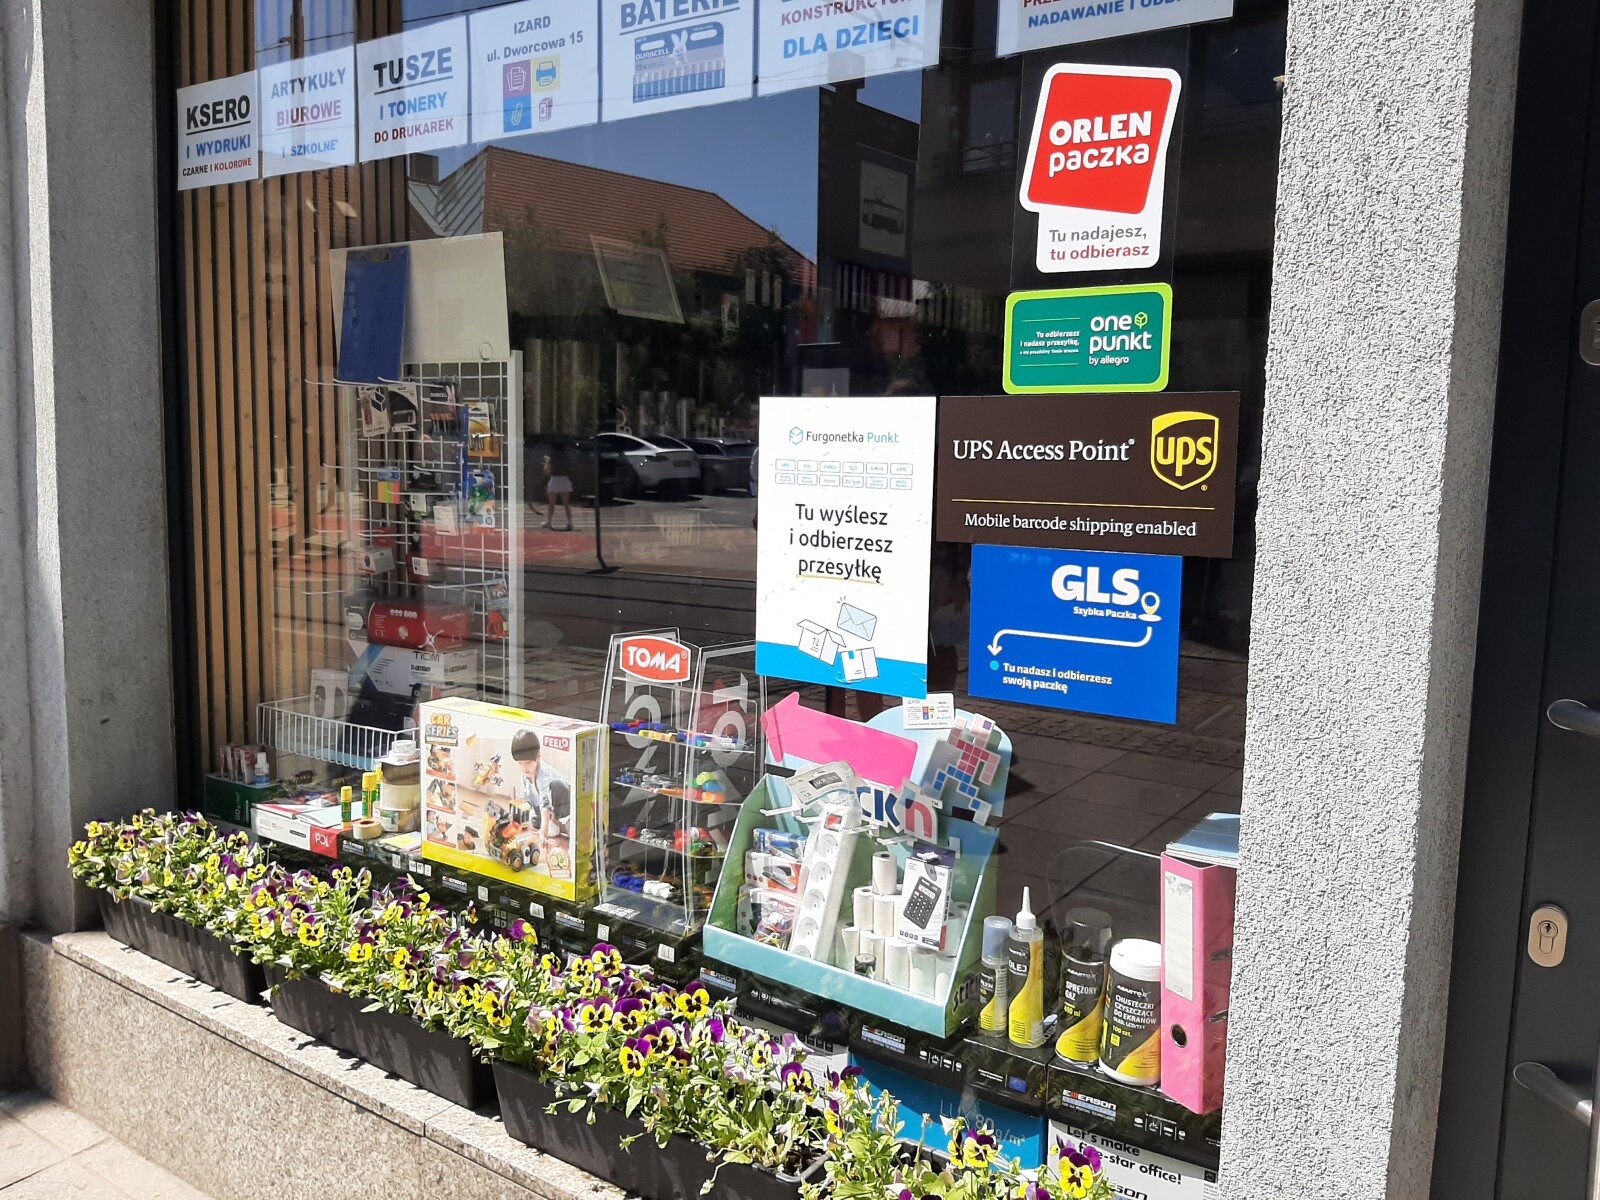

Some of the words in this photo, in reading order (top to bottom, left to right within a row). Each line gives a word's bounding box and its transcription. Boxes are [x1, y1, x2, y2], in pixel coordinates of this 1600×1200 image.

[514, 15, 551, 35] IZARD
[1028, 1, 1124, 28] NADAWANIE
[487, 47, 500, 63] ul.
[503, 36, 566, 59] Dworcowa
[570, 30, 584, 45] 15
[783, 33, 828, 59] DLA
[836, 15, 919, 49] DZIECI
[373, 47, 453, 88] TUSZE
[271, 67, 347, 99] ARTYKUŁY
[186, 94, 251, 130] KSERO
[276, 100, 342, 127] BIUROWE
[388, 91, 448, 118] TONERY
[374, 130, 389, 144] DO
[391, 118, 454, 141] DRUKAREK
[1049, 110, 1152, 146] ORLEN
[196, 134, 251, 156] WYDRUKI
[290, 139, 339, 156] SZKOLNE
[182, 165, 208, 177] CZARNE
[214, 158, 252, 172] KOLOROWE
[1049, 143, 1150, 178] paczka
[1049, 229, 1067, 242] Tu
[1071, 225, 1147, 243] nadajesz,
[1050, 248, 1066, 260] tu
[1070, 244, 1150, 260] odbierasz
[1045, 330, 1080, 338] odbierzesz
[1090, 314, 1132, 332] one
[1089, 331, 1152, 354] punkt
[1088, 356, 1099, 366] by
[1100, 355, 1130, 366] allegro
[806, 431, 864, 444] Furgonetka
[867, 431, 899, 444] Punkt
[953, 440, 993, 460] UPS
[996, 440, 1064, 460] Access
[1068, 440, 1130, 461] Point
[795, 503, 814, 521] Tu
[819, 504, 888, 526] wyślesz
[964, 513, 1011, 529] Mobile
[1012, 514, 1068, 531] barcode
[1069, 517, 1133, 537] shipping
[1135, 521, 1197, 537] enabled
[790, 527, 793, 545] i
[799, 529, 893, 553] odbierzesz
[799, 558, 882, 583] przesyłkę
[1051, 564, 1140, 606] GLS
[1073, 606, 1104, 617] Szybka
[1105, 609, 1137, 620] Paczka
[626, 645, 681, 673] TOMA
[1003, 662, 1016, 673] Tu
[1017, 665, 1051, 677] nadasz
[1057, 670, 1112, 684] odbierzesz
[1003, 676, 1032, 689] swoją
[1033, 680, 1068, 694] paczkę
[431, 712, 451, 726] CAR
[425, 724, 459, 738] SERIES
[543, 737, 569, 749] FEELO
[1008, 960, 1028, 972] OLEJ
[1065, 990, 1076, 1001] GAZ
[1115, 994, 1154, 1010] CHUSTECZKI
[1114, 1009, 1122, 1018] DO
[1123, 1012, 1157, 1024] EKRANÓW
[1067, 1125, 1098, 1143] Let's
[1101, 1138, 1141, 1157] make
[1139, 1164, 1182, 1185] office!
